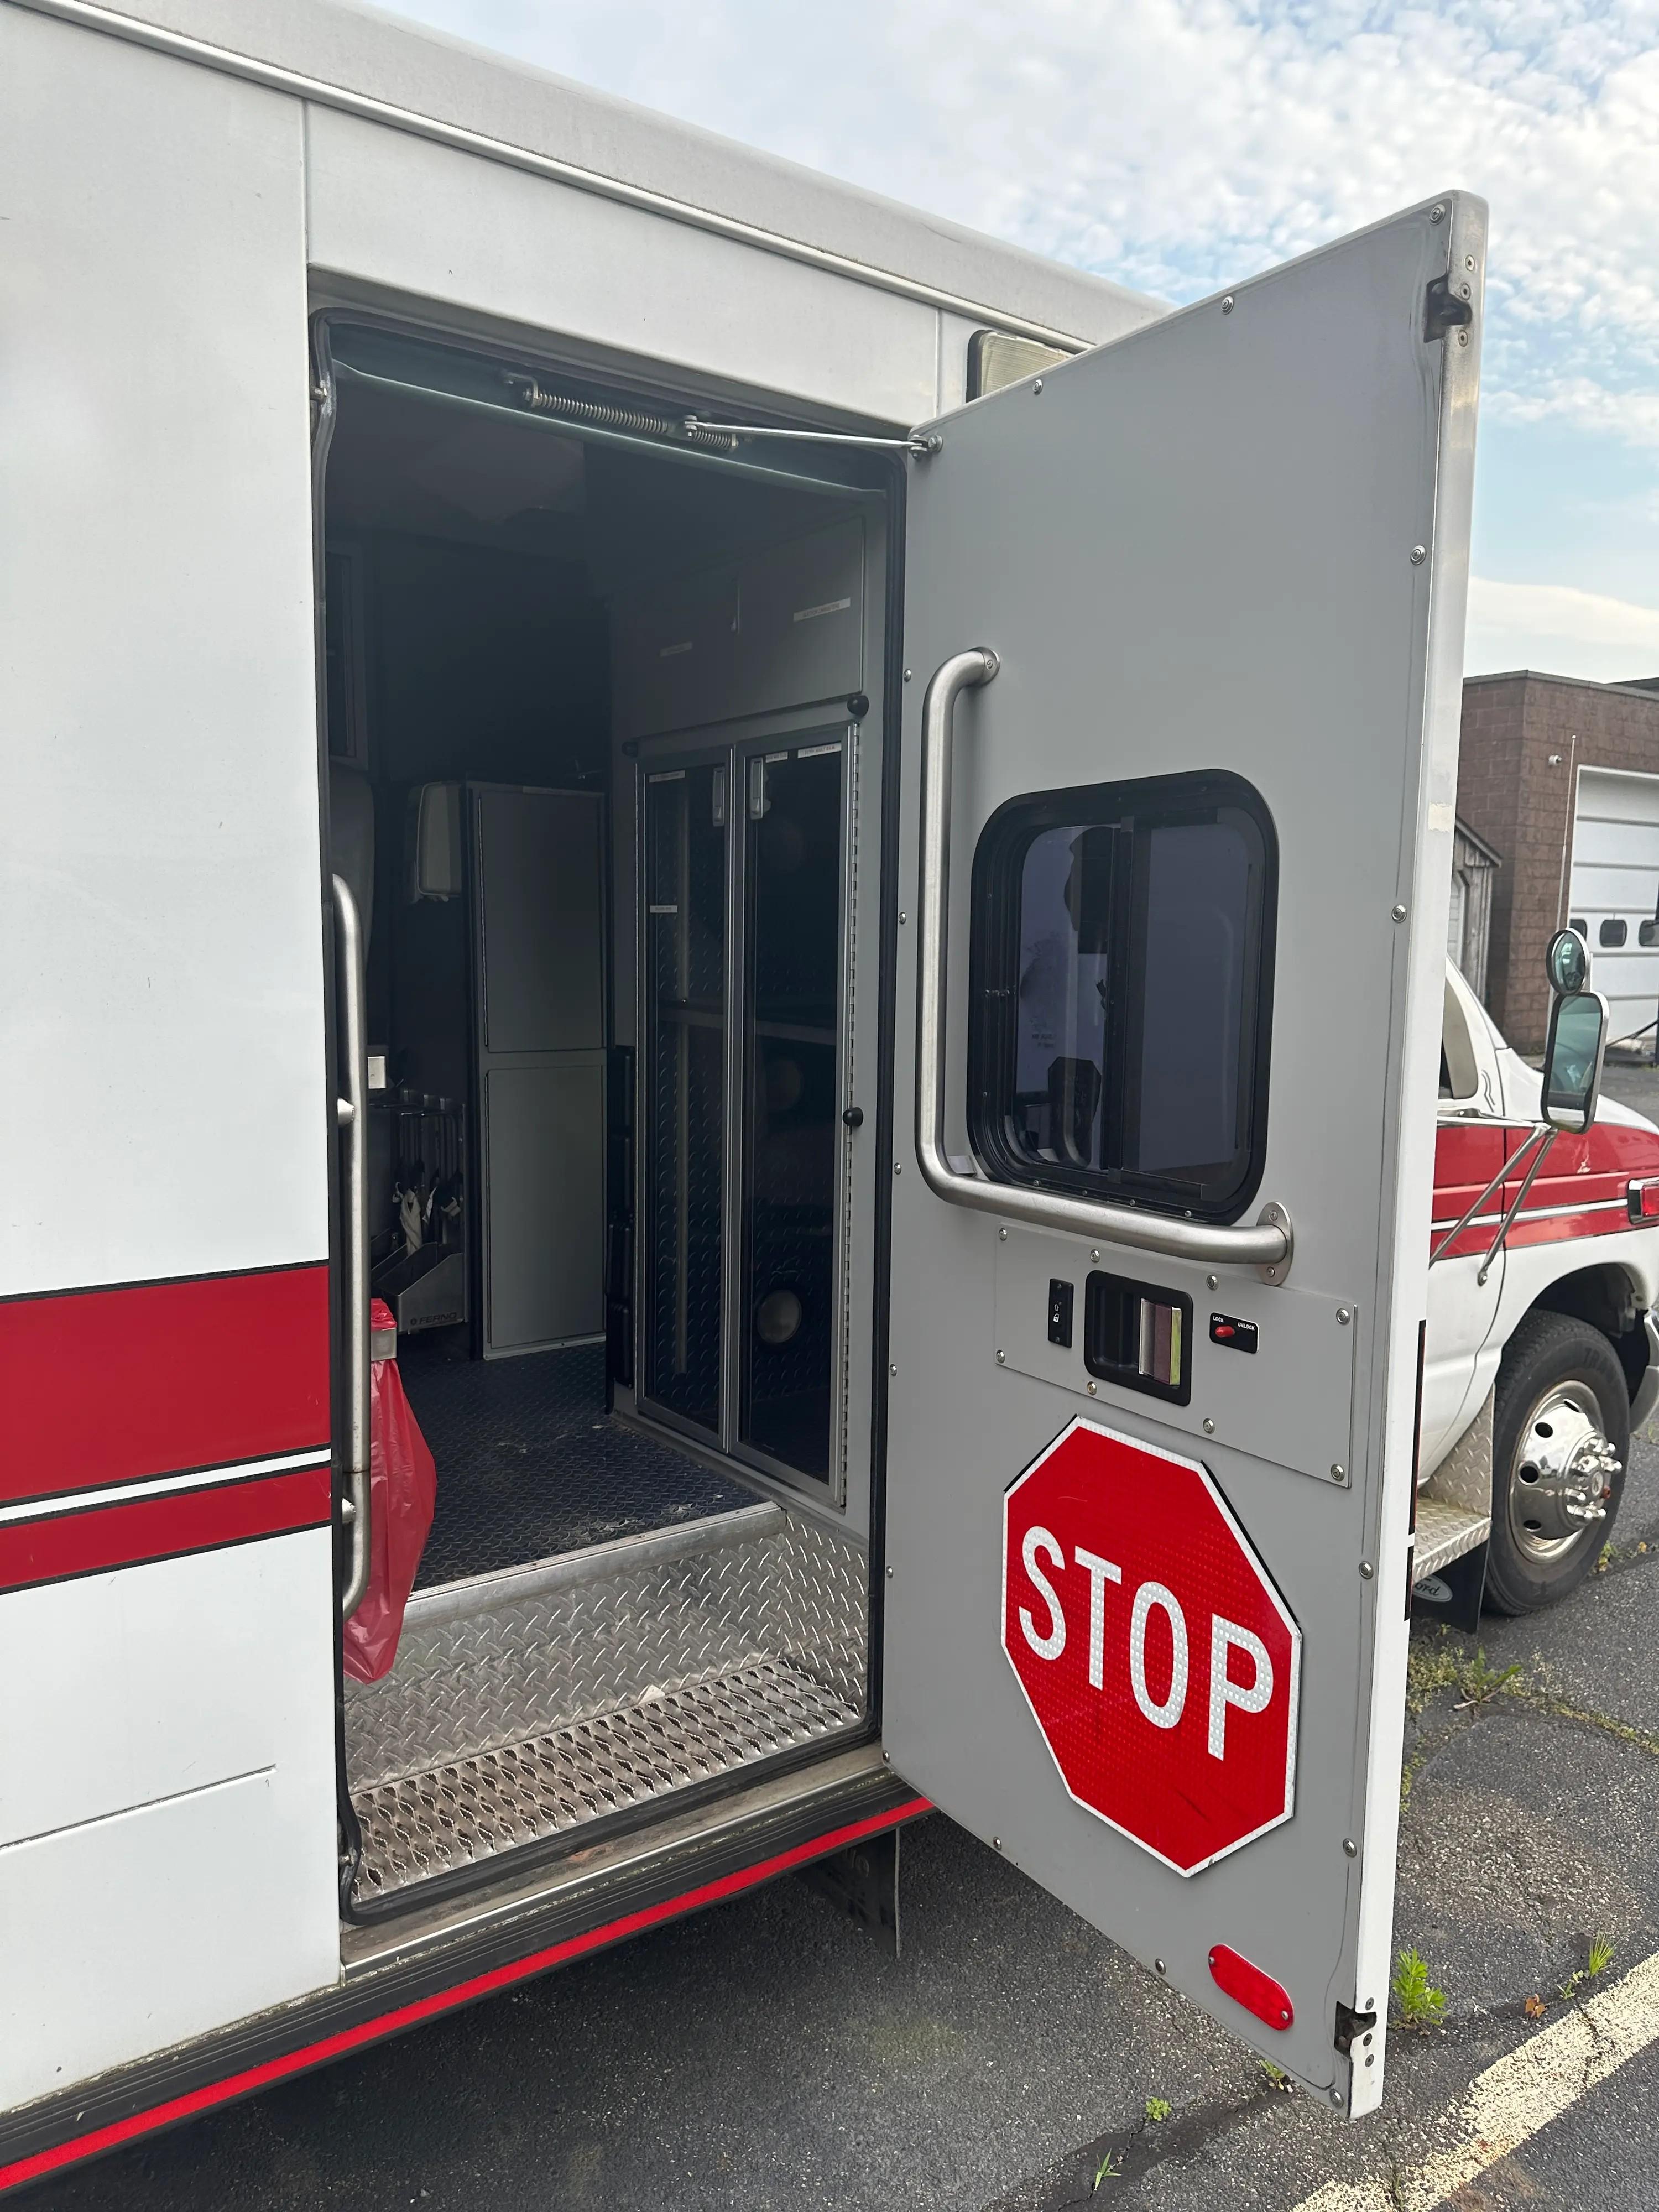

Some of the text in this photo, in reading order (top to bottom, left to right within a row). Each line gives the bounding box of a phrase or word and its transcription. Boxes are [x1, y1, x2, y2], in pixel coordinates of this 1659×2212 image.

[419, 1312, 457, 1324] FERNO
[1238, 1322, 1255, 1331] UNLOCK
[1019, 1526, 1274, 1761] STOP
